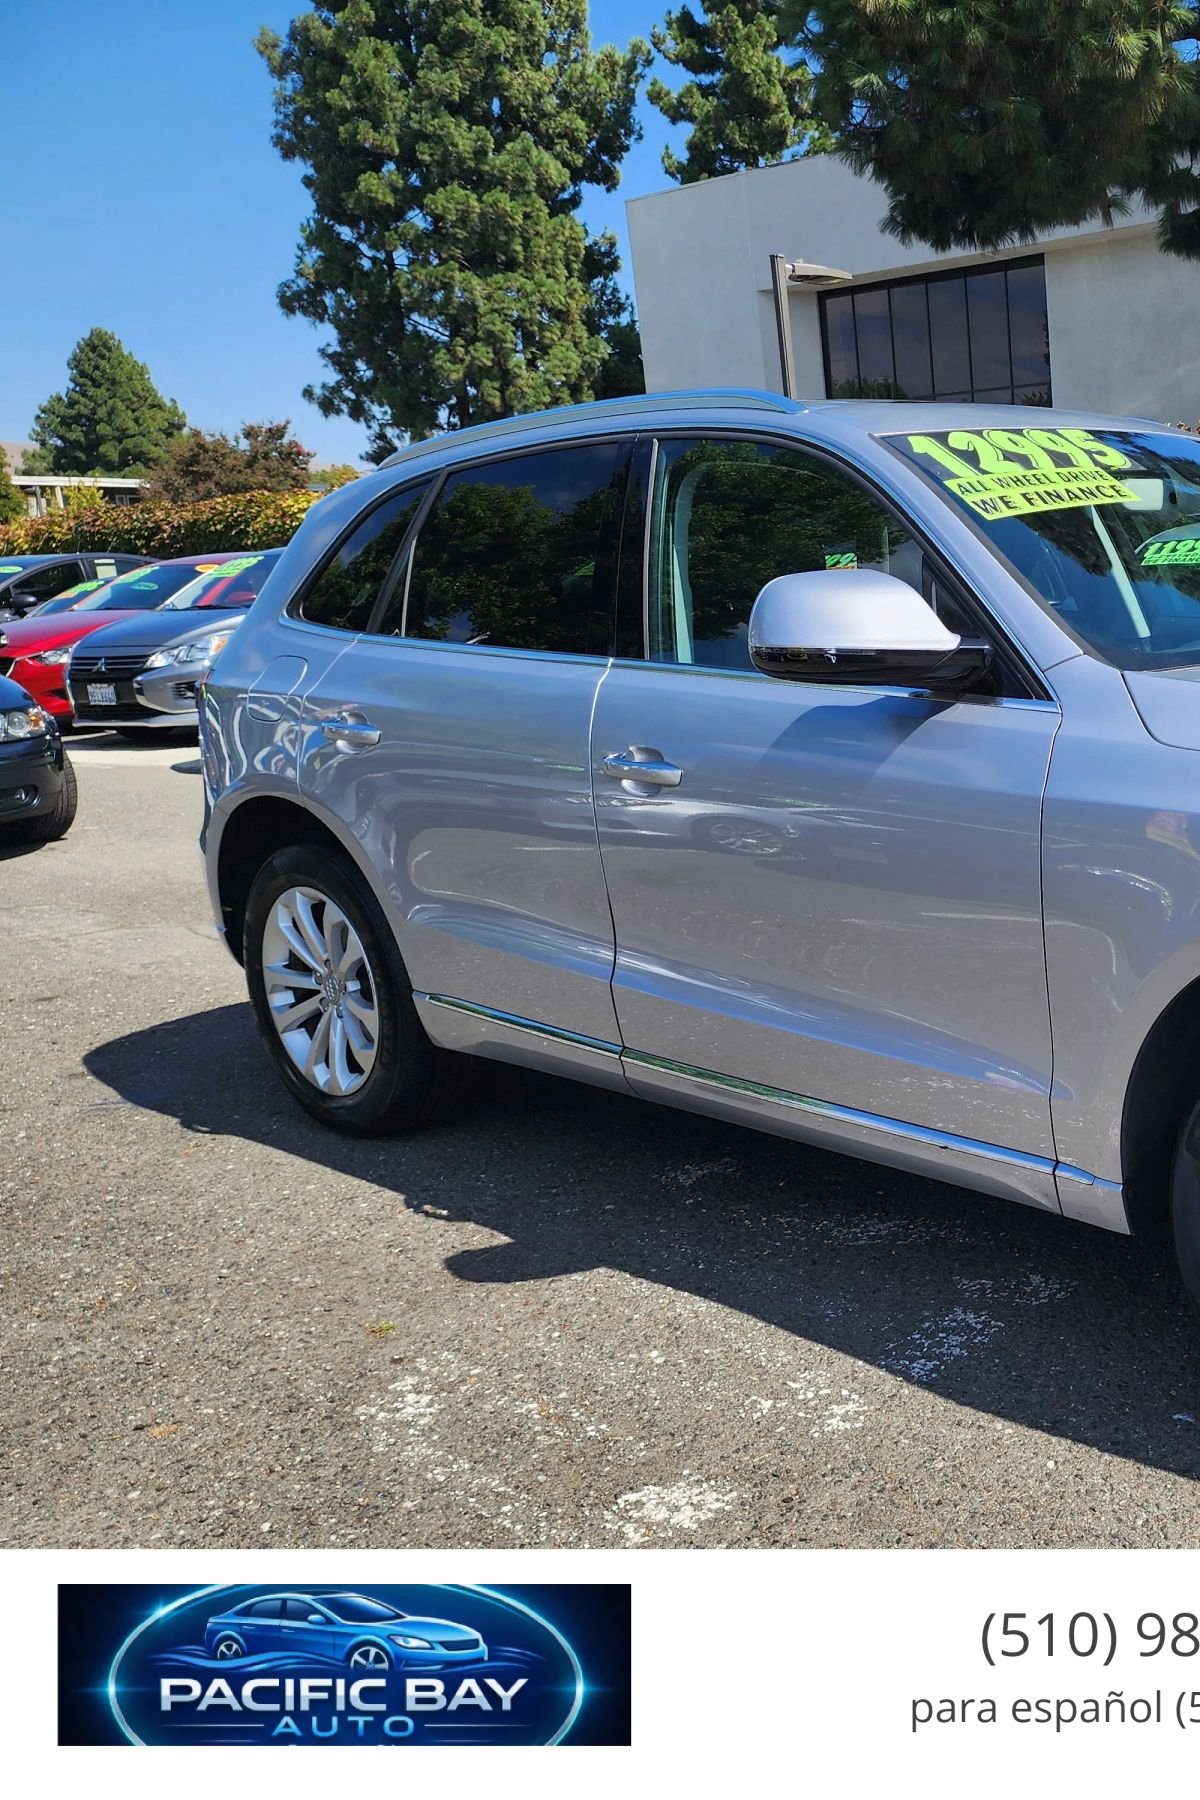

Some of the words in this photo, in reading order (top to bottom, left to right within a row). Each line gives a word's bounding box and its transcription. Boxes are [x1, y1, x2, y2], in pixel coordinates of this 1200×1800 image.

[907, 428, 1132, 479] 12995
[956, 480, 993, 496] ALL
[993, 474, 1057, 491] WHEEL
[1056, 469, 1111, 486] DRIVE
[971, 495, 1018, 515] WE
[1020, 484, 1129, 507] FINANCE
